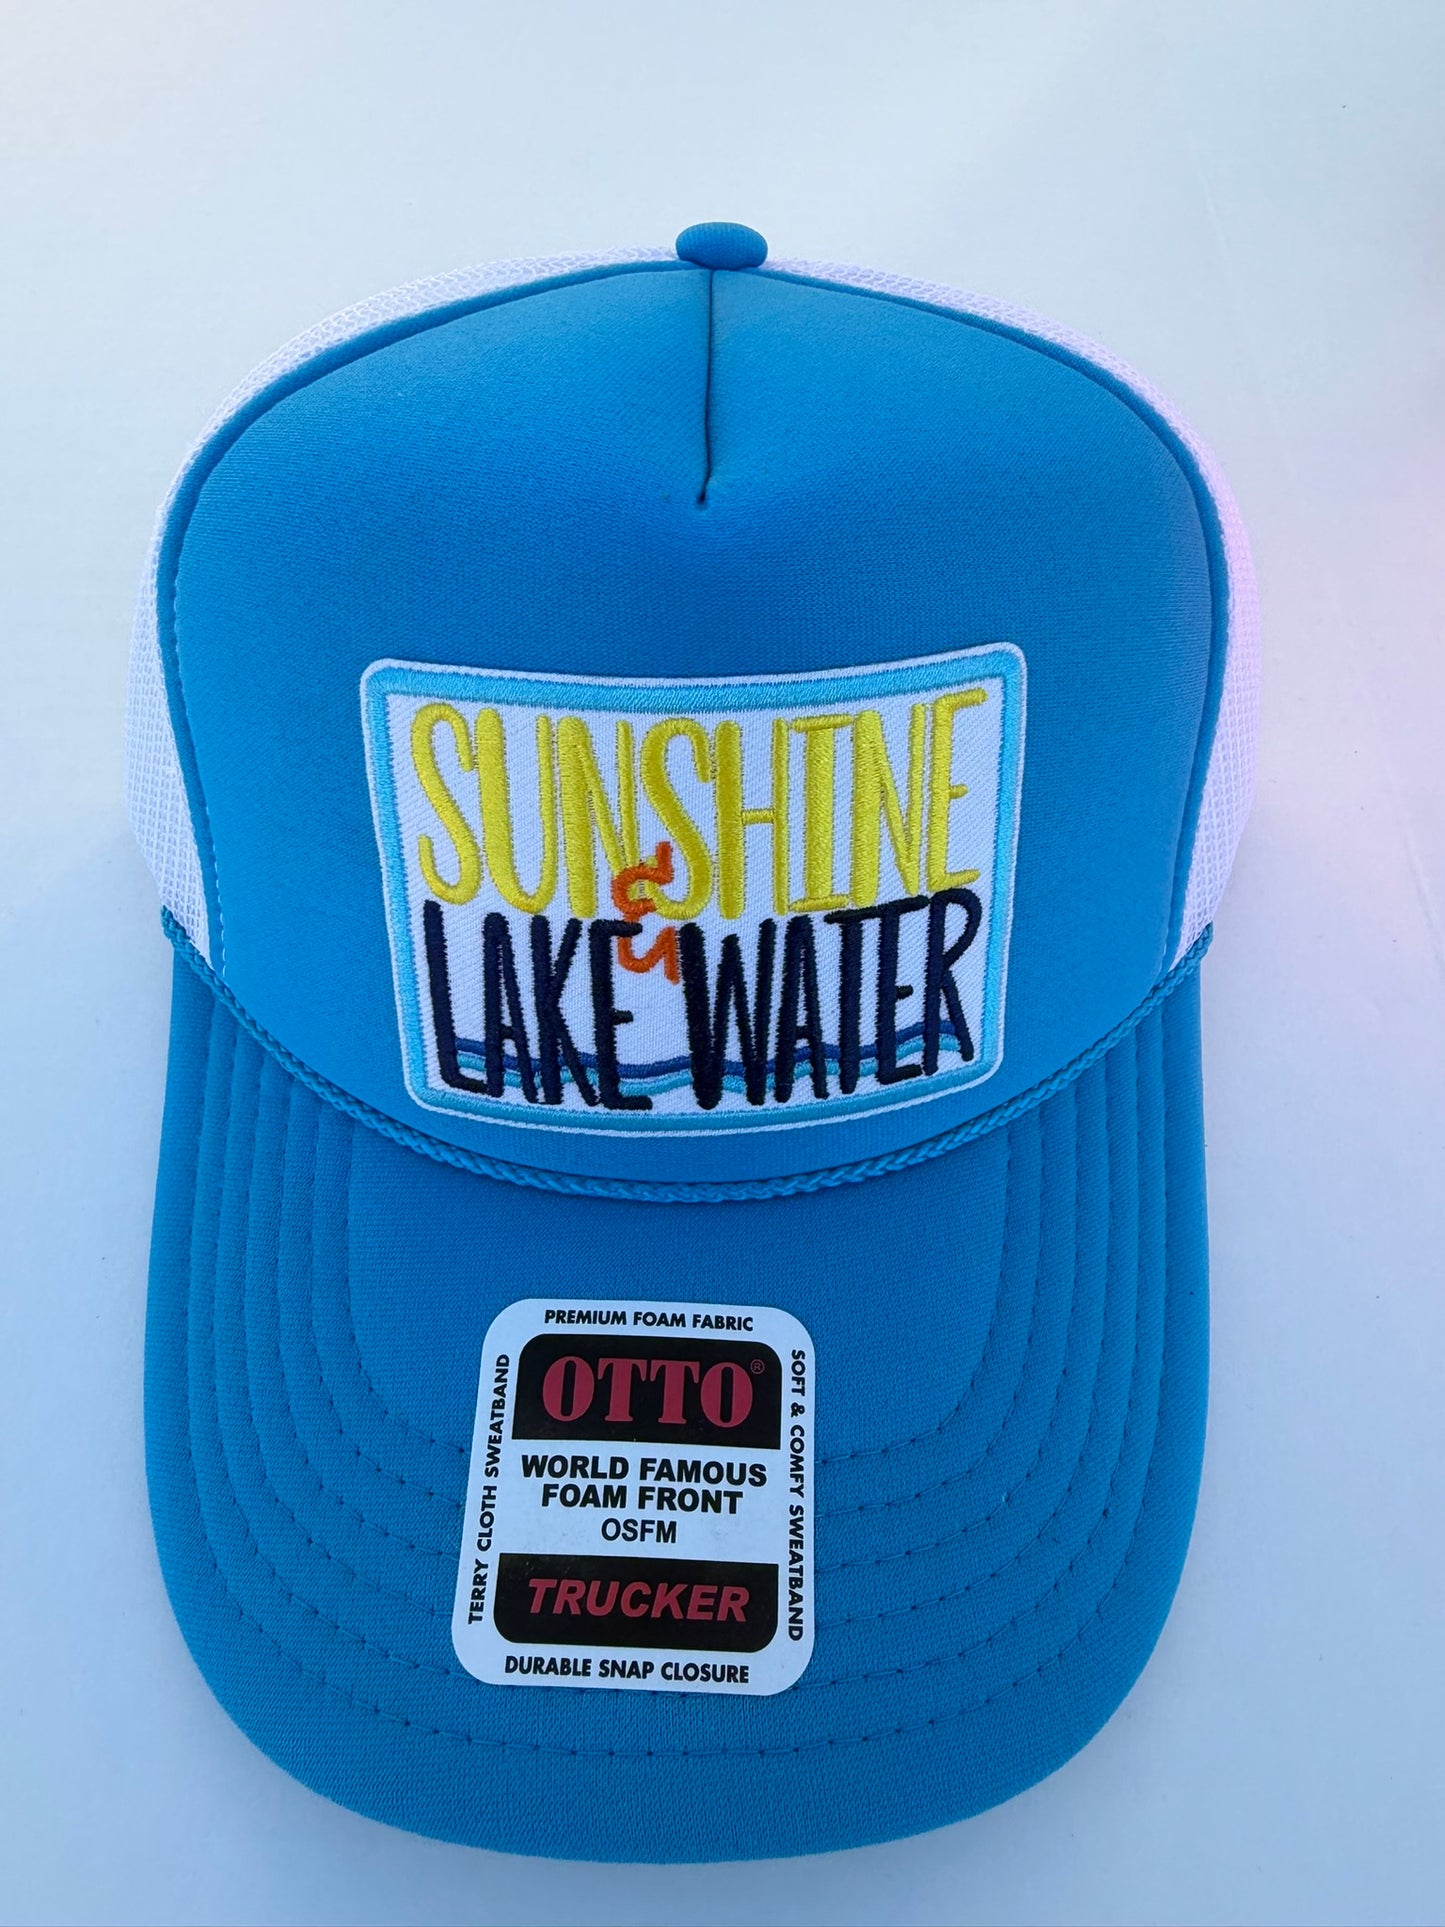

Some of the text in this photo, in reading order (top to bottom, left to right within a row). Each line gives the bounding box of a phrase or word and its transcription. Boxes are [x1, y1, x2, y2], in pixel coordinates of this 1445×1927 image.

[410, 687, 989, 920] SUNSHINE
[423, 888, 983, 1111] LAKE WATER
[544, 1309, 753, 1331] PREMIUM FOAM FABRIC
[468, 1354, 510, 1625] TERRY CLOTH SWEATBAND
[521, 1454, 767, 1487] WORLD FAMOUS
[541, 1484, 743, 1514] FOAM FRONT
[788, 1349, 805, 1641] SOFT & COMFY SWEATBAND
[601, 1518, 677, 1543] OSFM
[528, 1578, 750, 1623] TRUCKER
[505, 1656, 749, 1684] DURABLE SNAP CLOSURE
